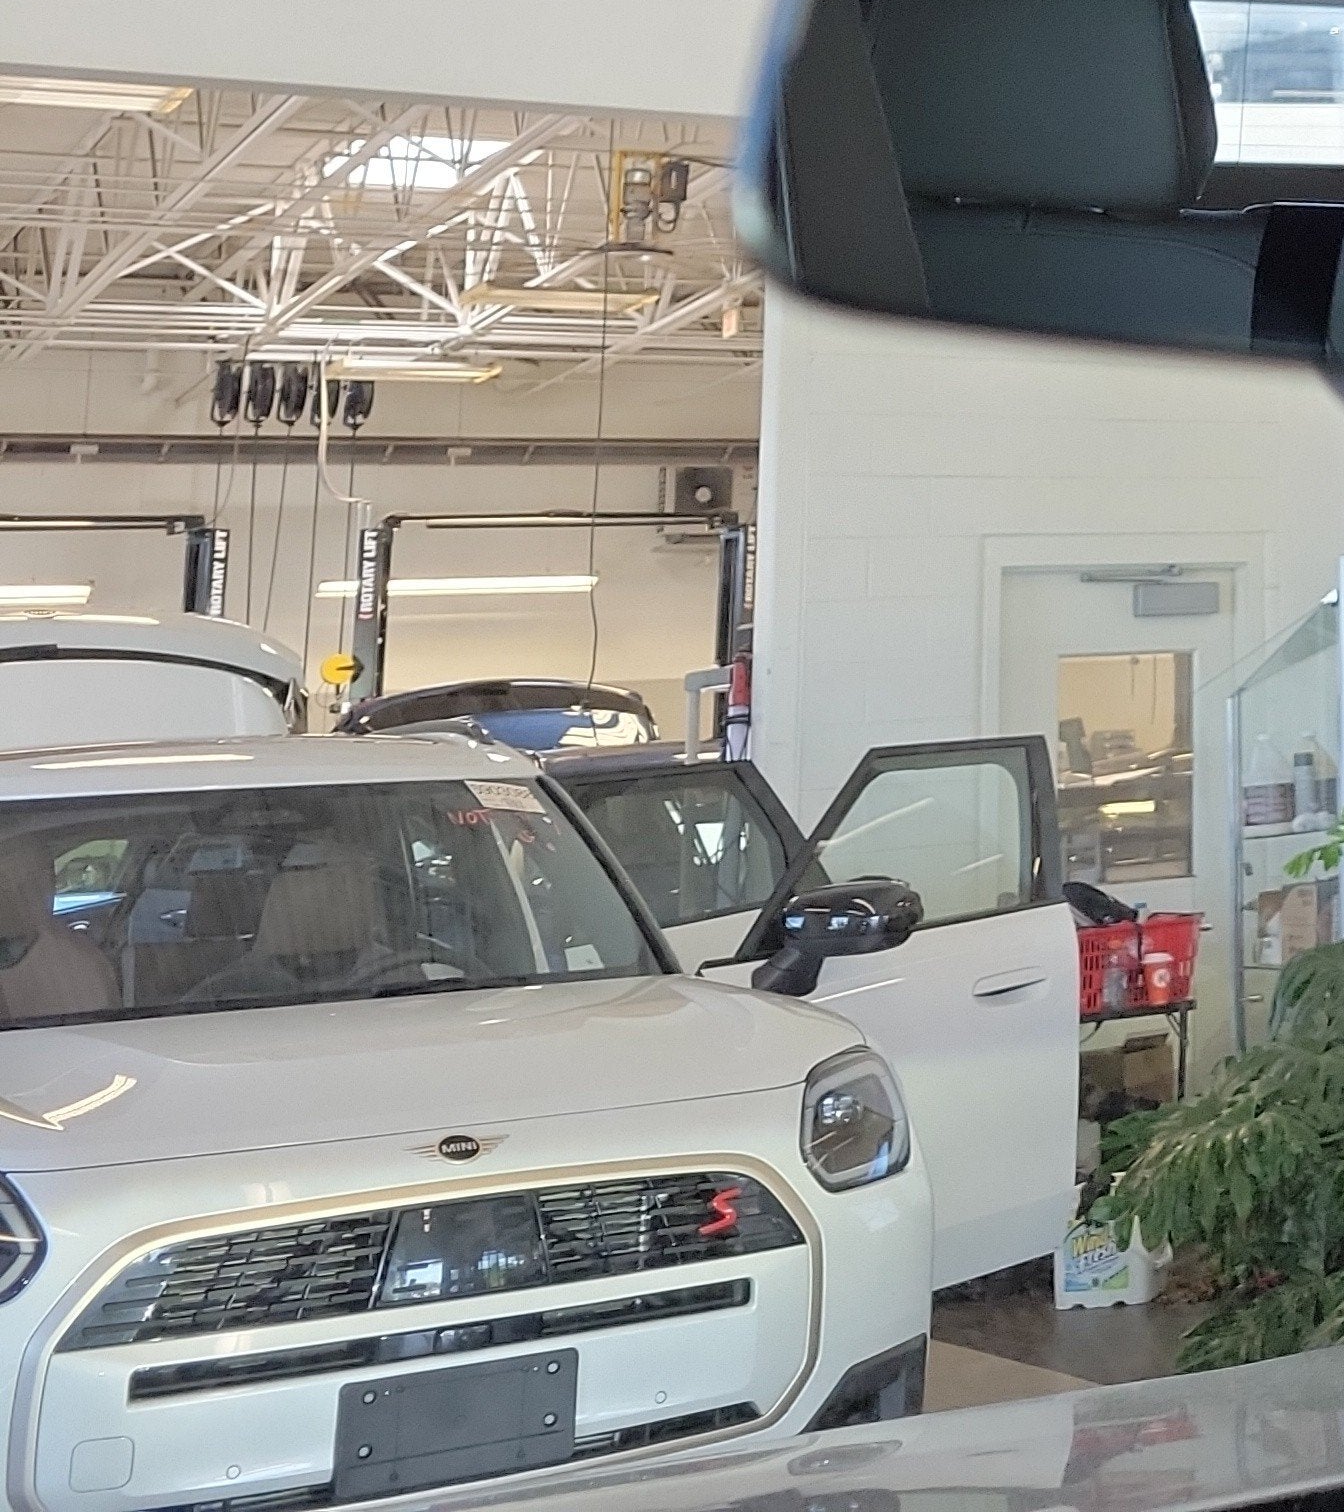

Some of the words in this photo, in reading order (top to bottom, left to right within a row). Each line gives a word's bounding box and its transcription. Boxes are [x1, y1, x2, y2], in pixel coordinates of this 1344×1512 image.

[214, 530, 228, 558] LIFT
[362, 529, 378, 559] LIFT
[210, 561, 225, 615] ROTARY
[359, 560, 376, 614] ROTARY
[440, 1140, 479, 1154] MINI
[697, 1185, 743, 1238] S
